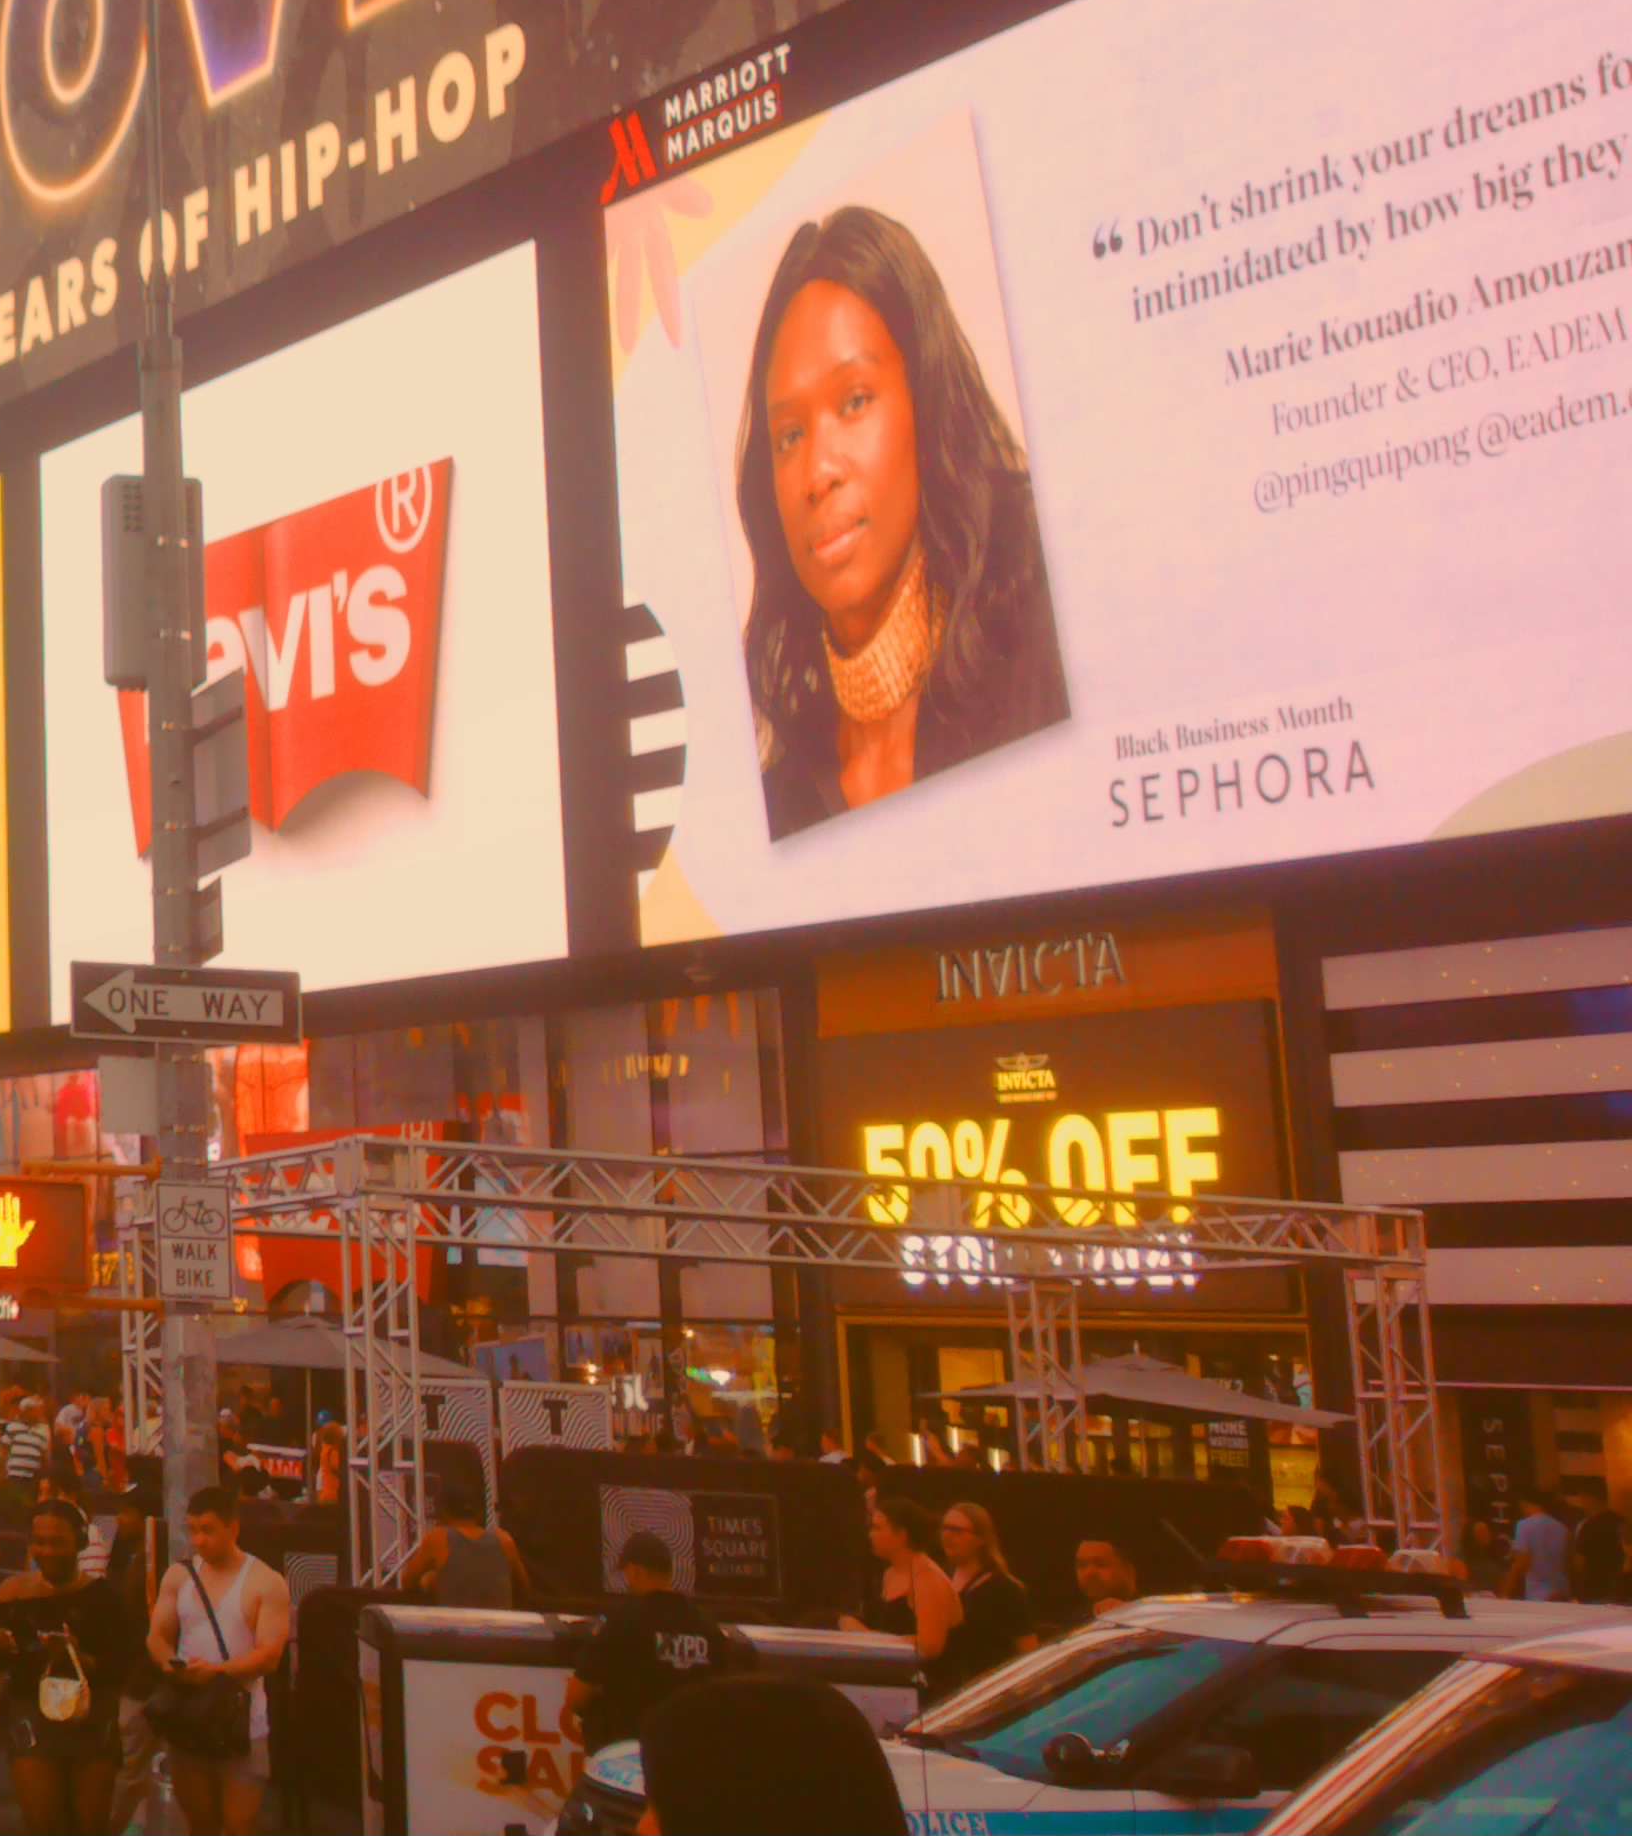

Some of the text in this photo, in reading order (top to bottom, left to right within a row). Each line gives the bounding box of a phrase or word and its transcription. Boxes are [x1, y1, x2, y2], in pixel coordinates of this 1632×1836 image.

[664, 42, 791, 129] MARRIOTT
[139, 186, 212, 285] OF
[234, 23, 527, 251] HIP-HOP
[667, 89, 778, 164] MARQUIS
[1230, 154, 1344, 223] shrink
[1352, 127, 1434, 193] your
[1444, 71, 1586, 145] dreams
[1133, 132, 1628, 321] intimidated by how big they
[1224, 331, 1314, 386] Marie
[1321, 291, 1458, 358] Kouadio
[1272, 305, 1629, 437] Founder & CEO, EADEM
[1253, 422, 1471, 513] @pingquipong
[1115, 696, 1353, 763] Black Business Month
[1109, 737, 1375, 828] SEPHORA
[107, 973, 269, 1021] ONE WAY
[937, 931, 1126, 1001] INVICTA
[997, 1069, 1055, 1091] INVICTA
[863, 1107, 1221, 1228] 50% OFF
[171, 1241, 218, 1262] WALK
[175, 1266, 216, 1289] BIKE
[702, 1539, 768, 1559] SQUARE
[707, 1516, 763, 1535] TIMES
